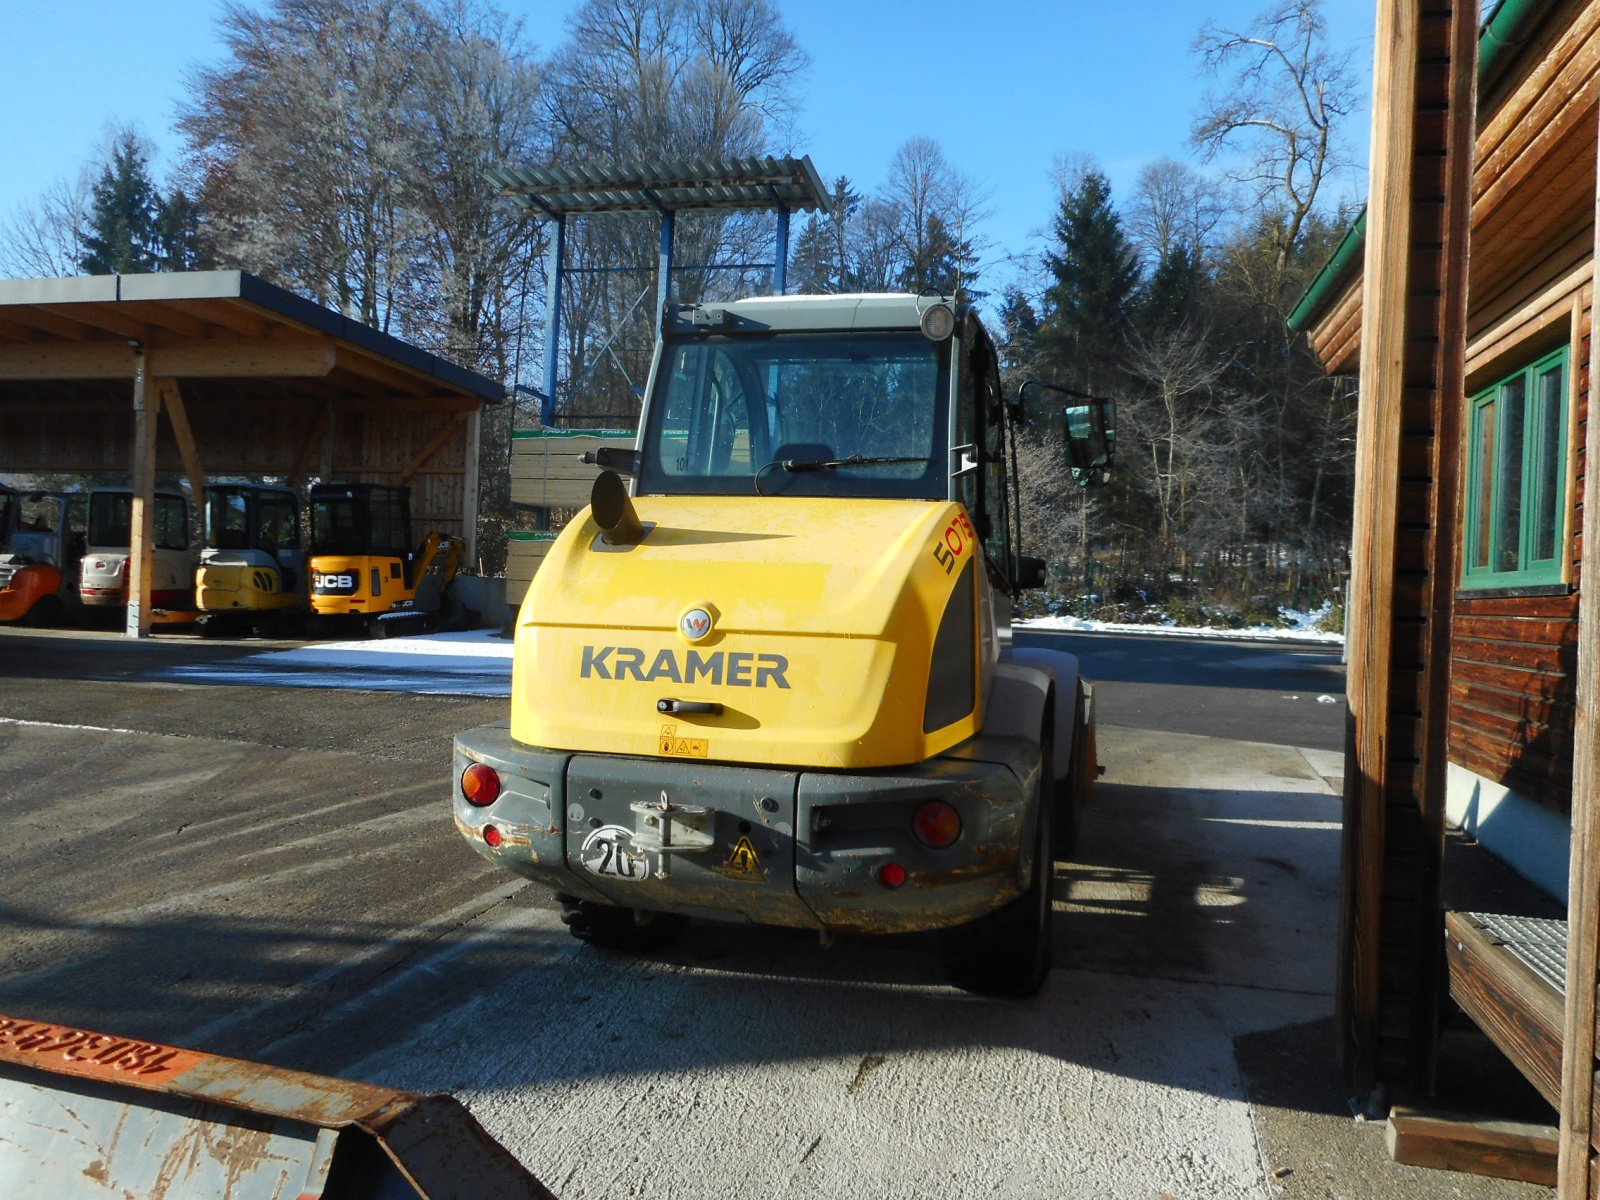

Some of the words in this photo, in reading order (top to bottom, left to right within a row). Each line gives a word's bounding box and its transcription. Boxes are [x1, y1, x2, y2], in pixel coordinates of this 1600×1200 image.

[933, 512, 974, 576] 5075
[315, 575, 352, 588] JCB
[580, 645, 792, 690] KRAMER
